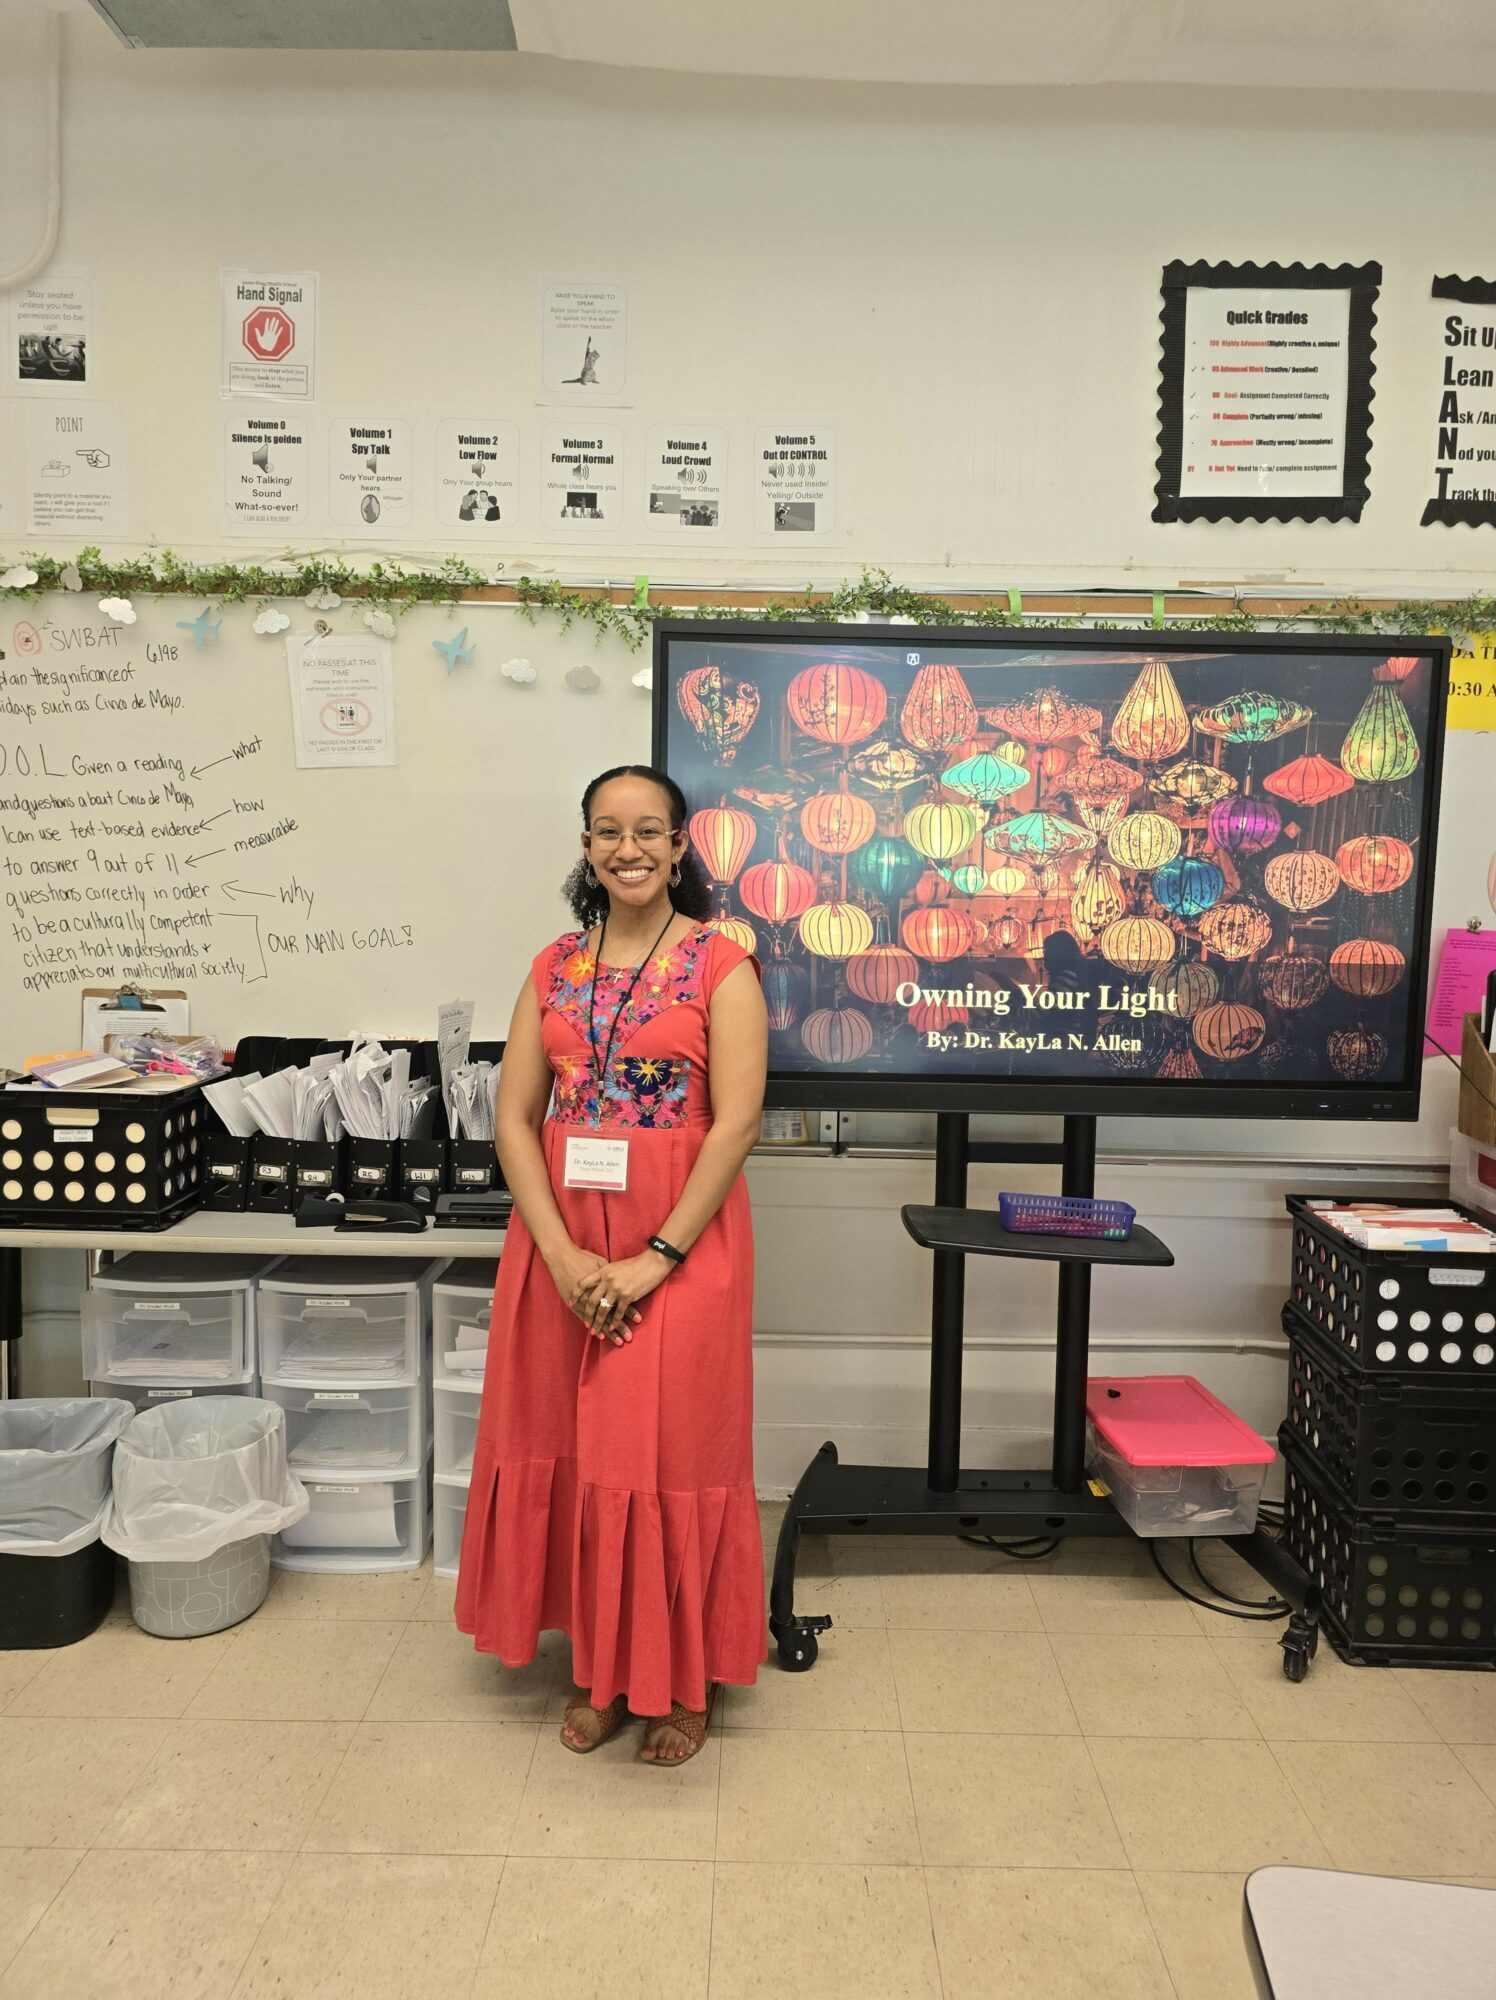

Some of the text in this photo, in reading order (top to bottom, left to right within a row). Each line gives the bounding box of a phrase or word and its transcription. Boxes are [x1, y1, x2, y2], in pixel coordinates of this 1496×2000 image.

[27, 290, 74, 299] Stay seated
[237, 286, 302, 305] Hand Signal
[18, 312, 60, 320] permission
[1226, 310, 1308, 325] Quick Grades
[1444, 316, 1476, 346] Sit
[1444, 356, 1494, 386] Lean
[1438, 391, 1474, 424] Ask
[56, 416, 83, 432] POINT
[248, 420, 286, 430] Volume 0
[232, 434, 302, 444] Silence is golden
[350, 428, 392, 439] Volume 1
[458, 434, 498, 446] Volume 2
[775, 435, 816, 445] Volume 5
[352, 444, 390, 455] Spy Talk
[563, 438, 603, 449] Volume 3
[667, 440, 707, 451] Volume 4
[1438, 427, 1474, 460] Nod
[459, 450, 497, 460] Low Flow
[552, 453, 614, 464] Formal Normal
[662, 455, 712, 466] Loud Crowd
[764, 450, 827, 460] Out Of CONTROL
[241, 475, 292, 486] No Talking/
[340, 474, 356, 482] Only
[443, 478, 458, 487] Only
[252, 489, 282, 498] Sound
[652, 484, 681, 492] Speaking
[235, 502, 299, 512] What-so-ever!
[50, 626, 124, 652] SWBAT
[41, 699, 73, 714] such
[75, 700, 90, 711] as
[95, 694, 127, 710] Cinco
[132, 694, 146, 710] de
[232, 734, 263, 760] what
[72, 753, 186, 782] Given a reading
[117, 790, 146, 806] Cinco
[148, 789, 160, 806] de
[233, 798, 265, 814] how
[39, 828, 62, 842] use
[151, 820, 201, 839] evidence
[234, 817, 299, 853] measurable
[4, 856, 23, 876] to
[30, 859, 80, 875] answer
[87, 848, 100, 872] 9
[104, 853, 129, 874] out
[135, 852, 156, 874] of
[85, 884, 146, 912] correctly
[153, 887, 168, 900] in
[172, 882, 210, 900] order
[13, 922, 32, 943] to
[32, 915, 58, 935] be
[150, 907, 214, 936] competent
[268, 932, 300, 954] OUR
[23, 937, 199, 968] citizen that understands
[22, 964, 94, 992] appreciates
[96, 964, 116, 976] our
[122, 962, 198, 982] multicultural
[895, 982, 1178, 1018] Owning Your Light
[926, 1031, 1142, 1054] By: Dr. KayLa N. Allen
